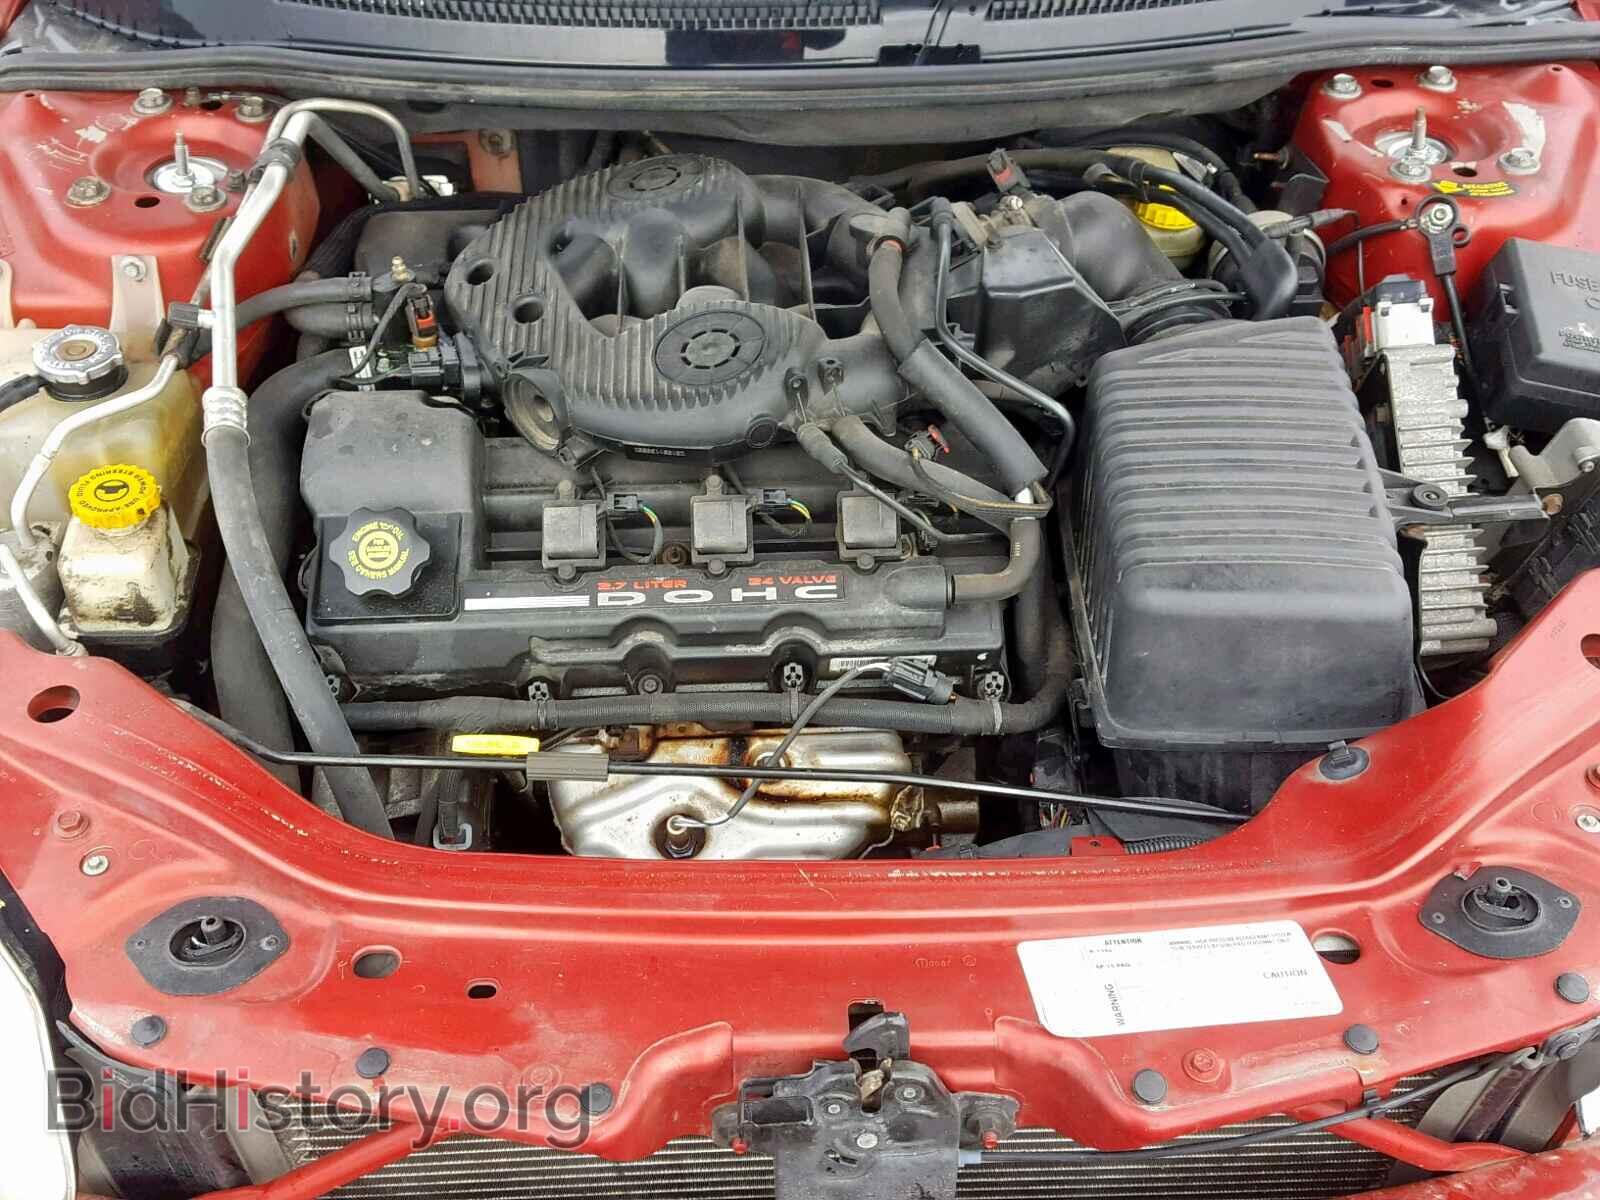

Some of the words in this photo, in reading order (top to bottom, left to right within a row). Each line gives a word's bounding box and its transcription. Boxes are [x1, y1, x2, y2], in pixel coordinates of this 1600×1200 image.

[633, 579, 688, 589] LITER
[748, 577, 774, 586] 24
[779, 575, 837, 584] VALVE
[597, 585, 838, 606] DOHC
[1104, 984, 1126, 1026] WARNING
